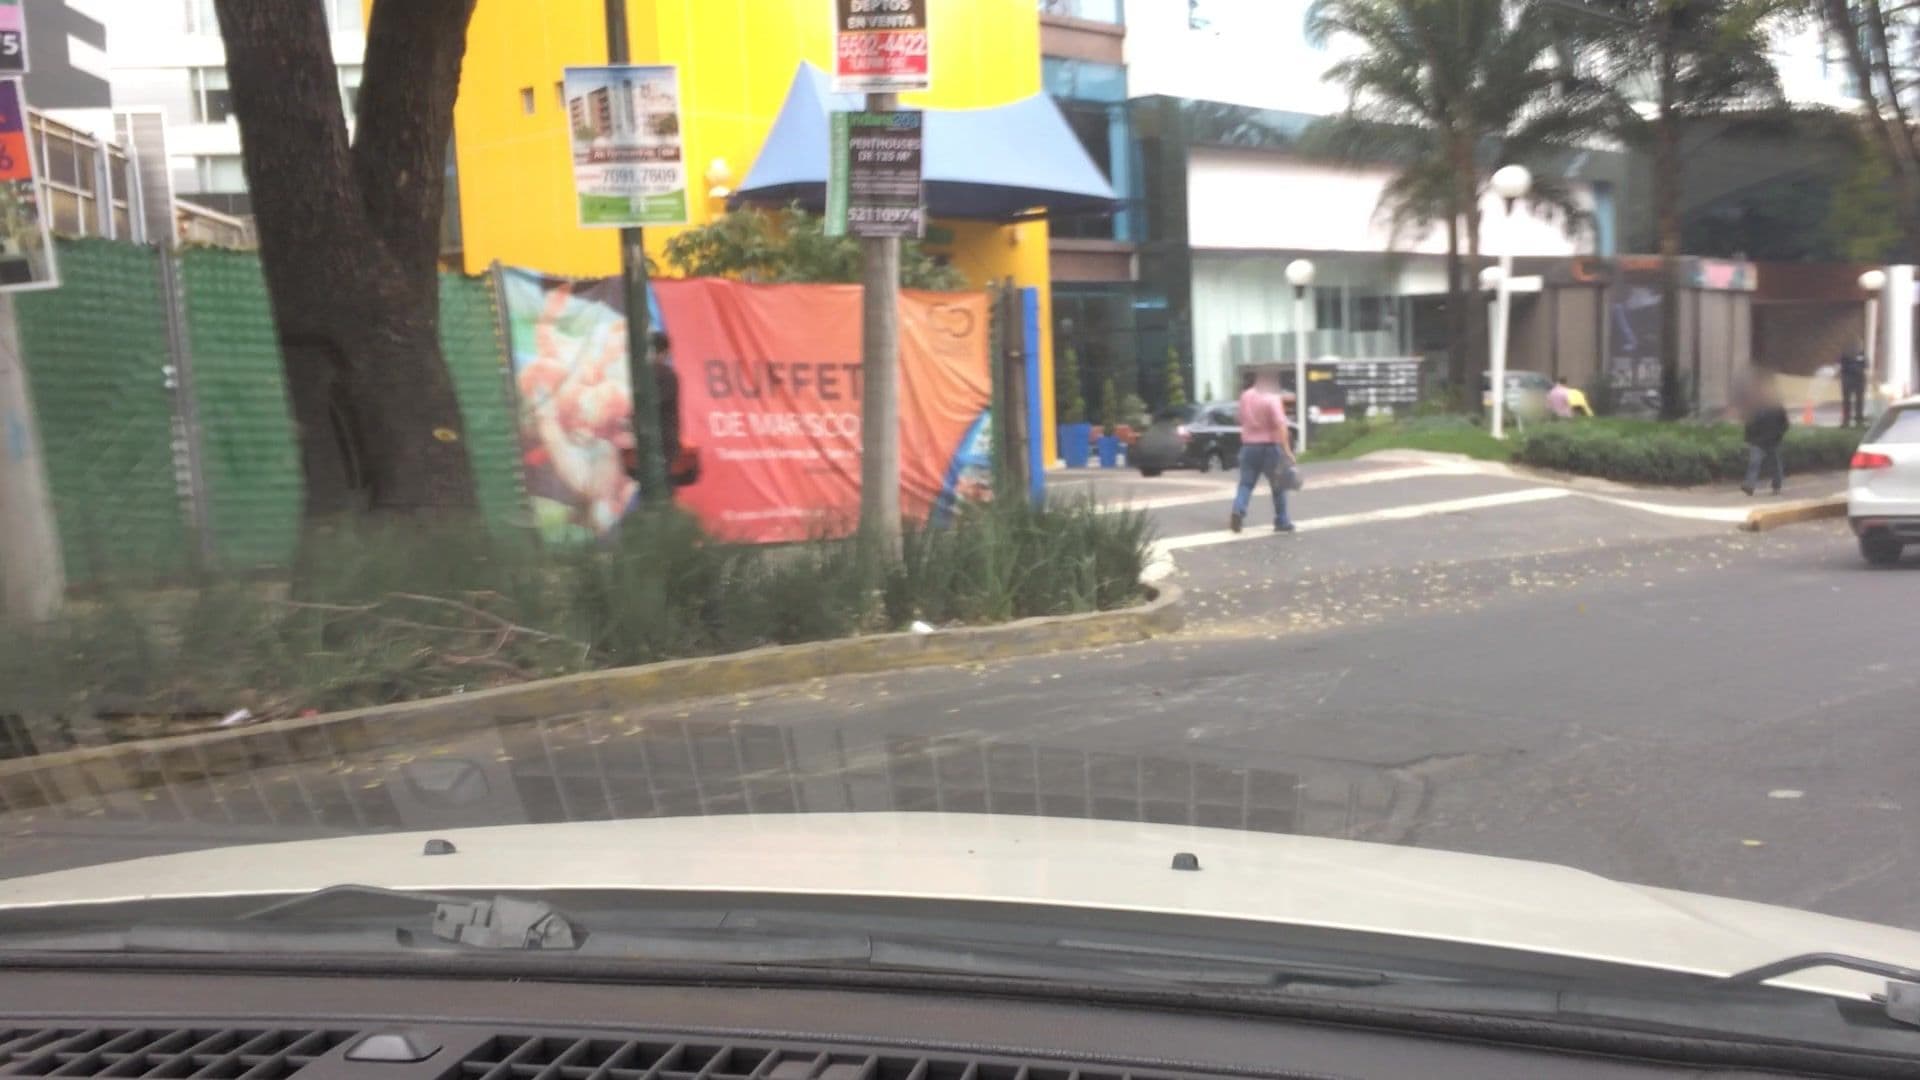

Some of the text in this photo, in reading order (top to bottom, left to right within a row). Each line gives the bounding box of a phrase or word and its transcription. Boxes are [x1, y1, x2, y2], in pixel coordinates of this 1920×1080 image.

[850, 0, 911, 12] DEPTOS
[868, 14, 916, 28] VENTA
[849, 137, 922, 149] PENTHOUSES
[704, 359, 863, 400] BUFFET
[708, 411, 747, 437] DE
